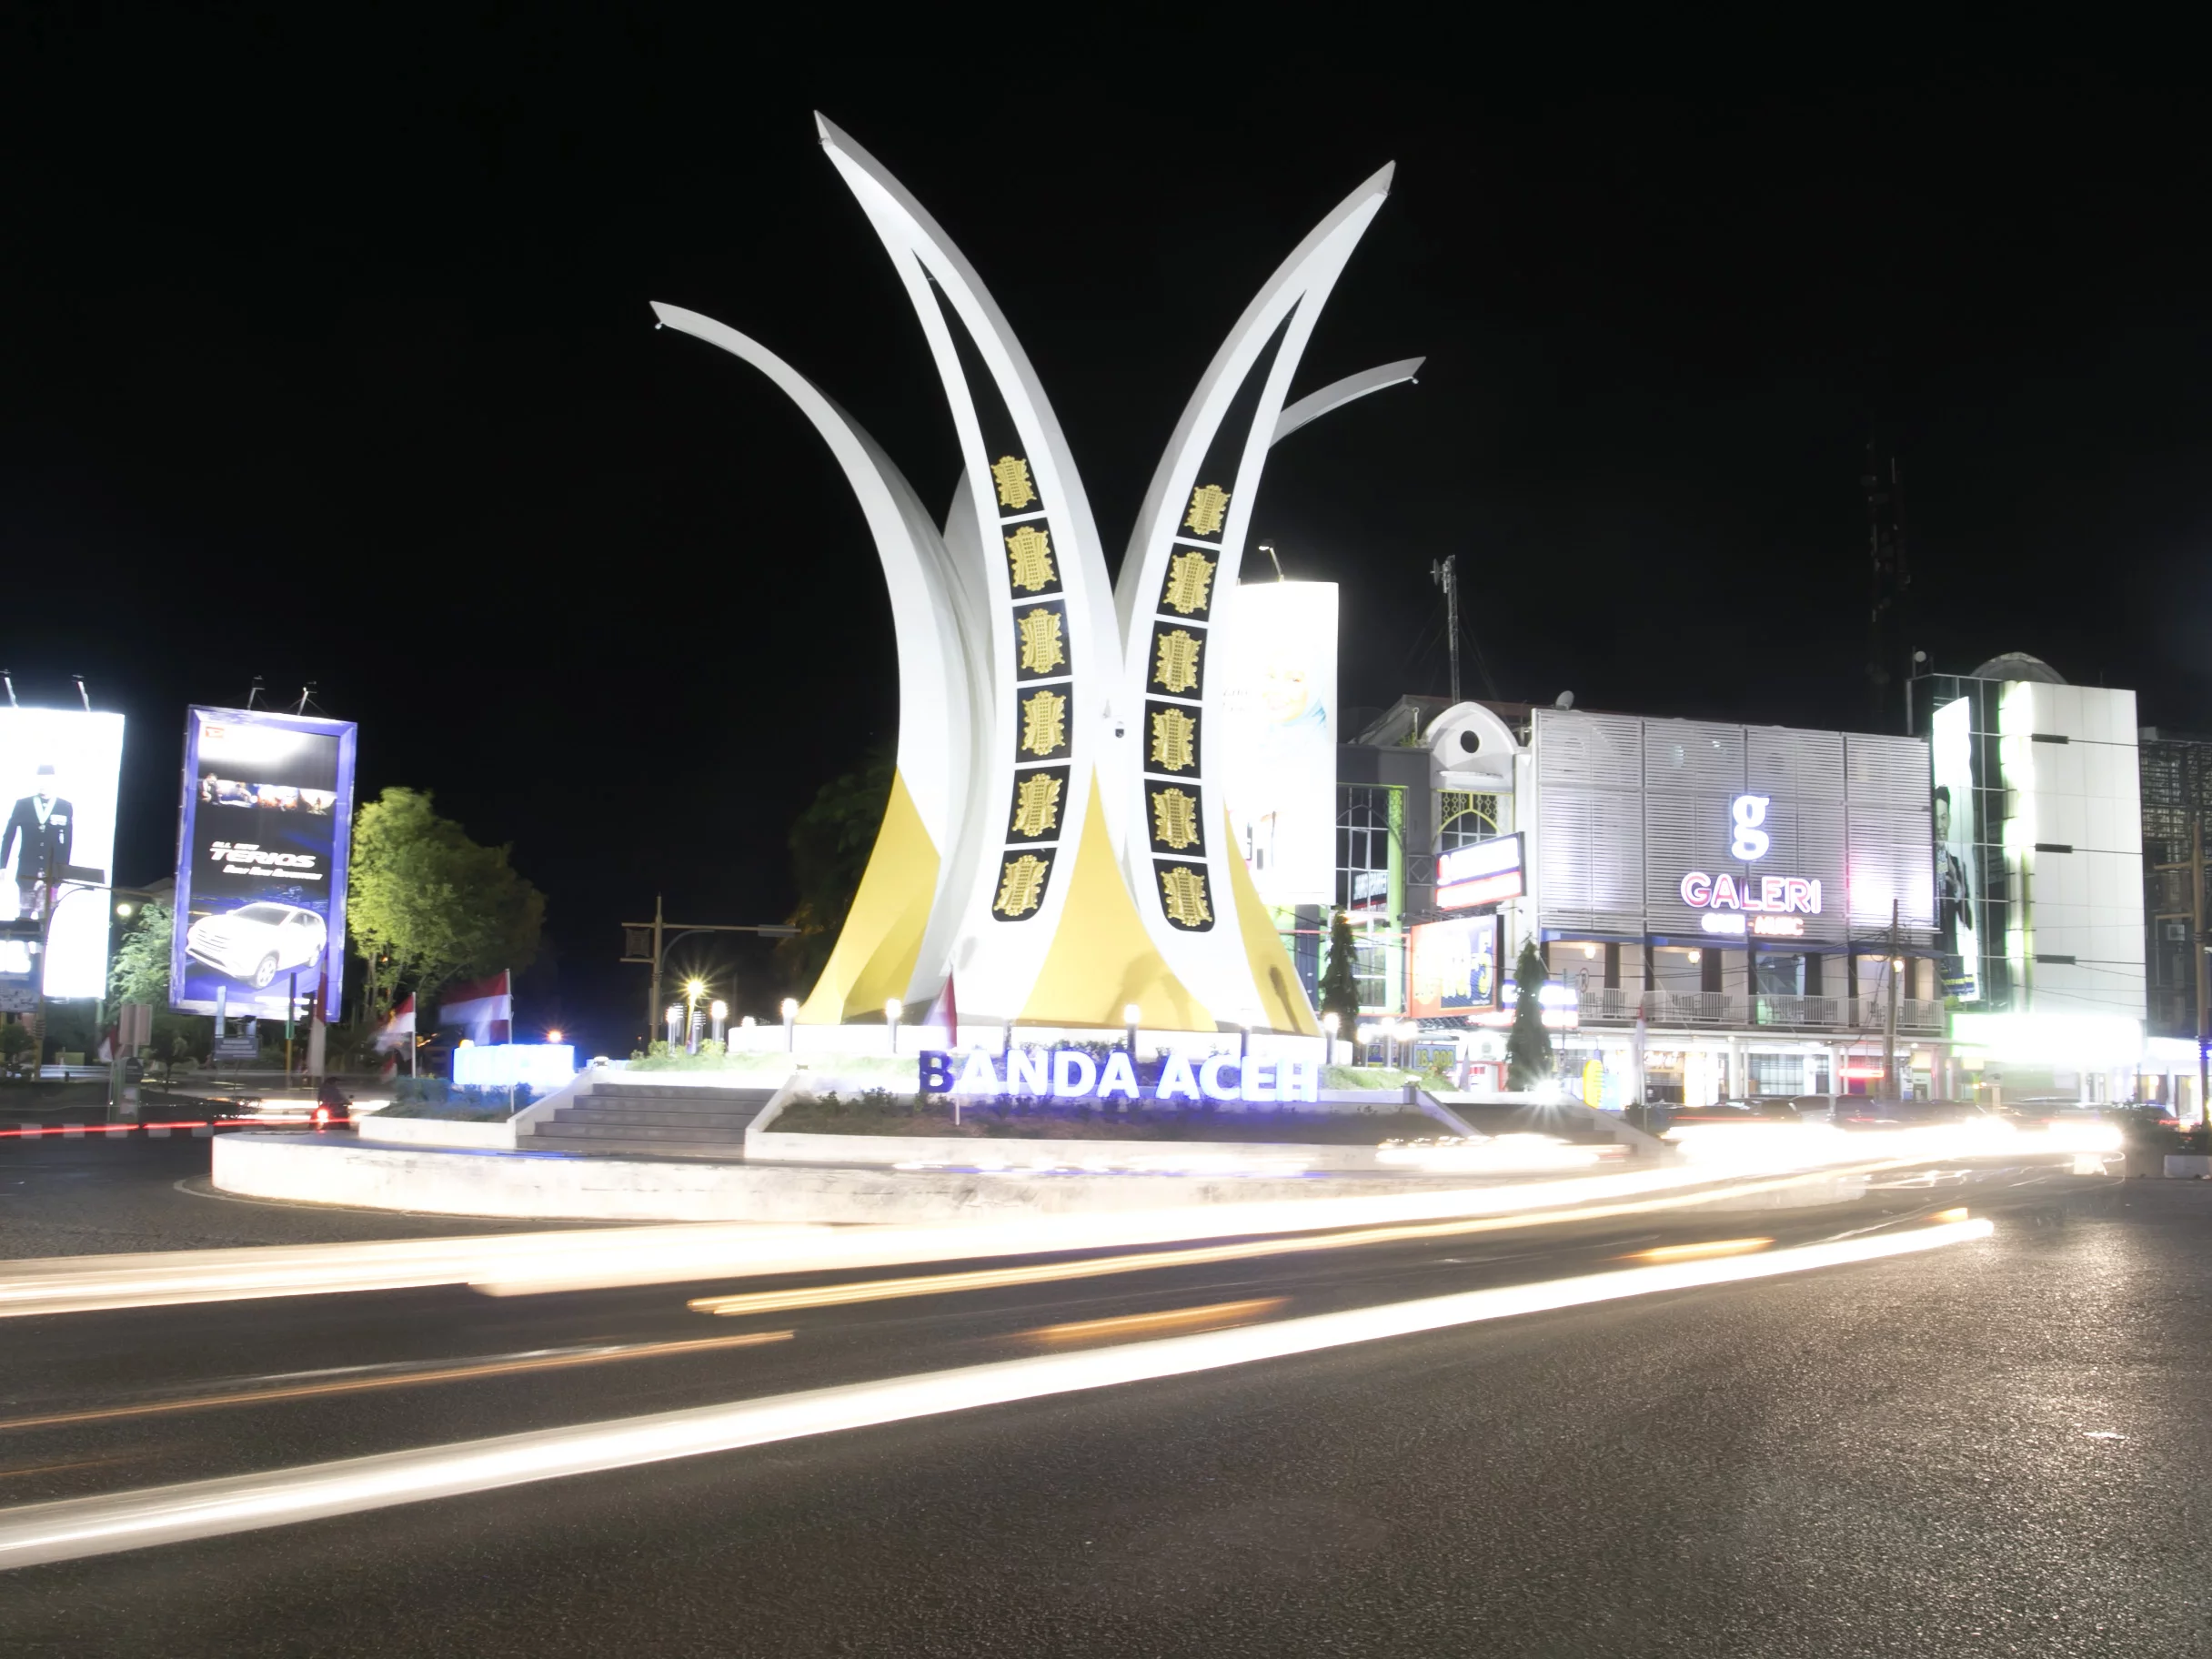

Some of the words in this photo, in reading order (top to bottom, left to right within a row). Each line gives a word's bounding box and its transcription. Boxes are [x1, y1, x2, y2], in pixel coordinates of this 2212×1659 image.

[209, 848, 317, 868] TERIOS
[1681, 872, 1822, 914] GALERI
[920, 1048, 1141, 1099] BANDA
[1154, 1052, 1319, 1102] ACEH
